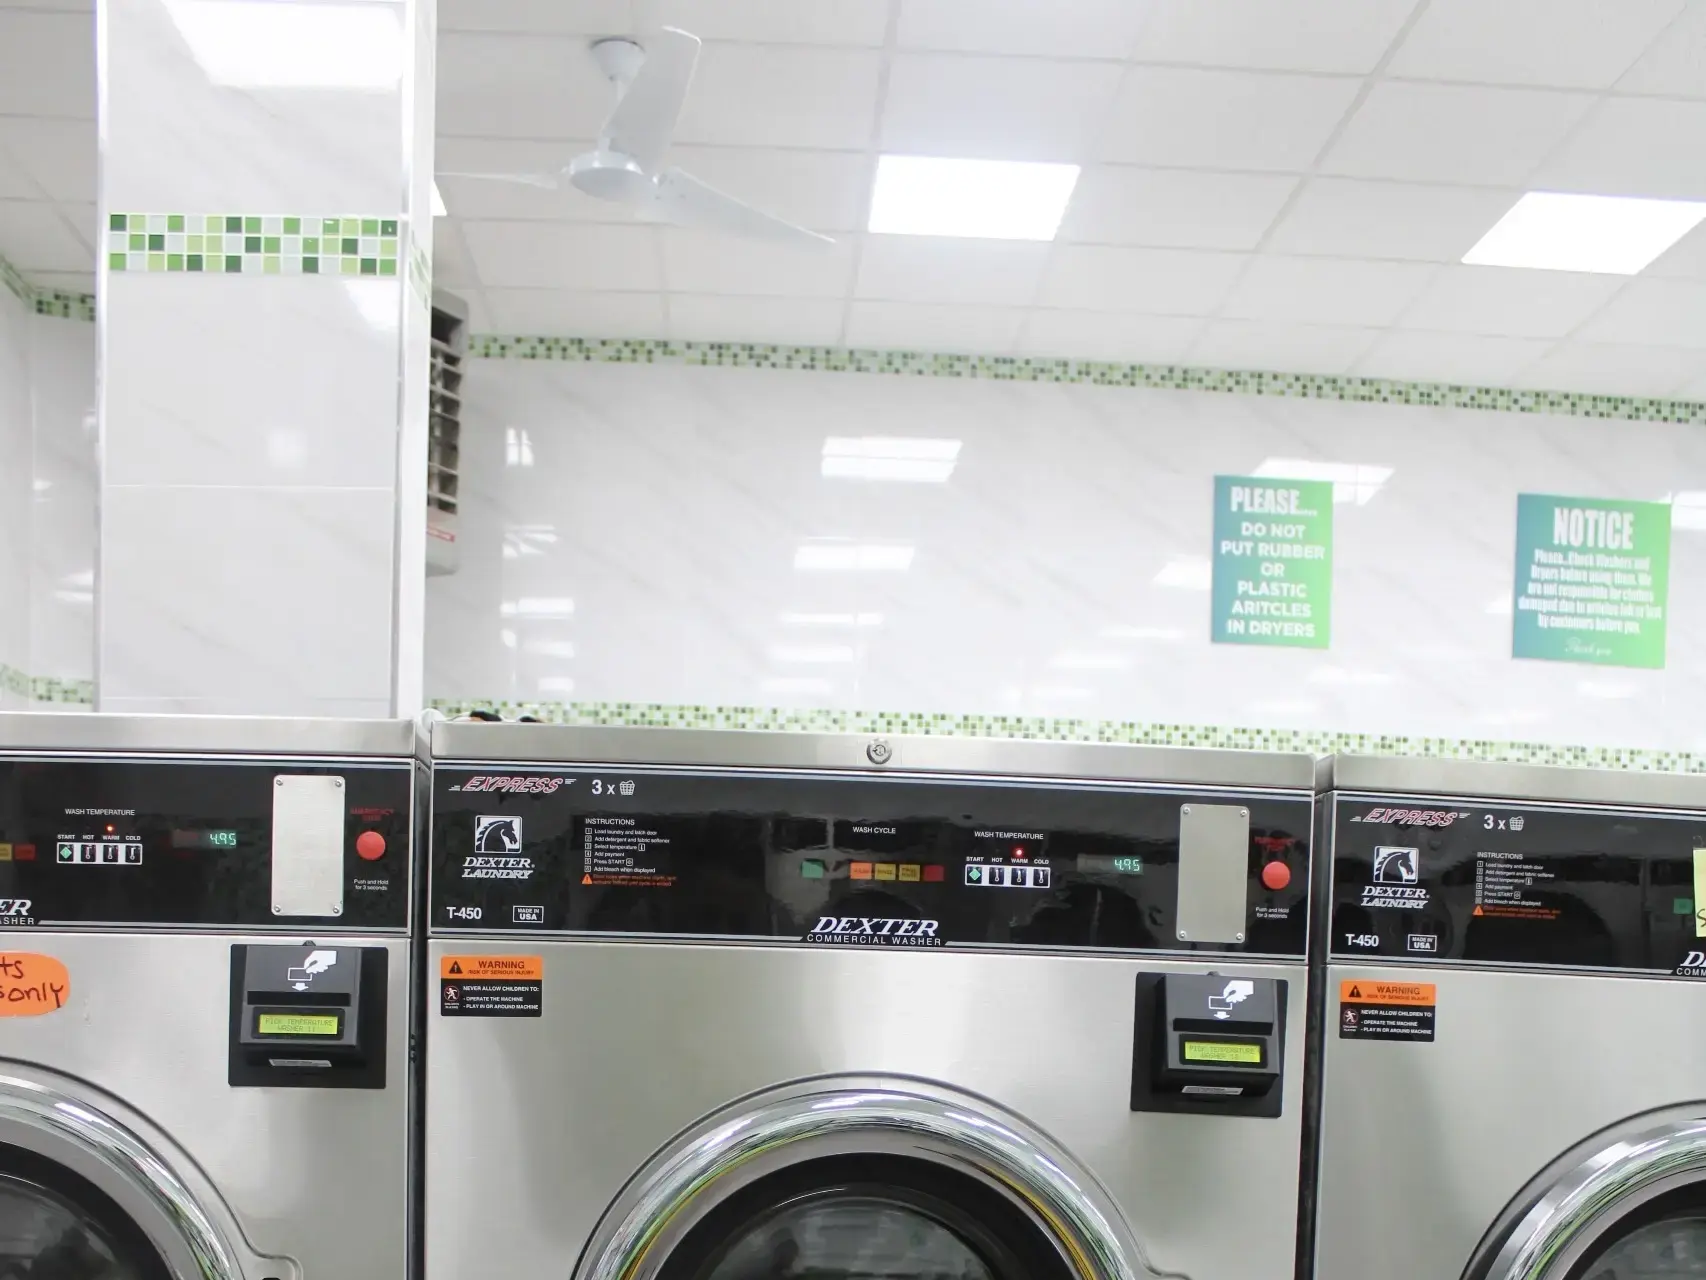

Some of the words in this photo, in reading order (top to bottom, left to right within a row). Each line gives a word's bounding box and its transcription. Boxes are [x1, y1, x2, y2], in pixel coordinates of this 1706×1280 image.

[1241, 522, 1266, 536] DO
[1271, 523, 1306, 539] NOT
[1553, 507, 1634, 549] NOTICE
[1221, 540, 1254, 555] PUT
[1258, 542, 1325, 559] RUBBER
[1260, 562, 1285, 576] OR
[1238, 581, 1307, 598] PLASTIC
[1232, 600, 1311, 617] ARITCLES
[1227, 619, 1244, 634] IN
[1250, 621, 1315, 637] DRYERS
[462, 776, 563, 793] EXPRESS
[592, 779, 602, 795] 3
[1362, 808, 1458, 826] EXPRESS
[1483, 815, 1494, 829] 3
[996, 832, 1044, 840] TEMPERATURE
[463, 857, 531, 868] DEXTER
[1477, 852, 1523, 860] INSTRUCTIONS
[462, 869, 533, 879] LAUNDRY
[1362, 886, 1426, 898] DEXTER
[1361, 898, 1428, 909] LAUNDRY
[446, 907, 482, 919] T-450
[811, 916, 938, 936] DEXTER
[807, 934, 886, 944] COMMERCIAL
[892, 937, 940, 945] WASHER
[1345, 934, 1379, 947] T-450
[479, 960, 525, 969] WARNING
[1377, 986, 1420, 995] WARNING
